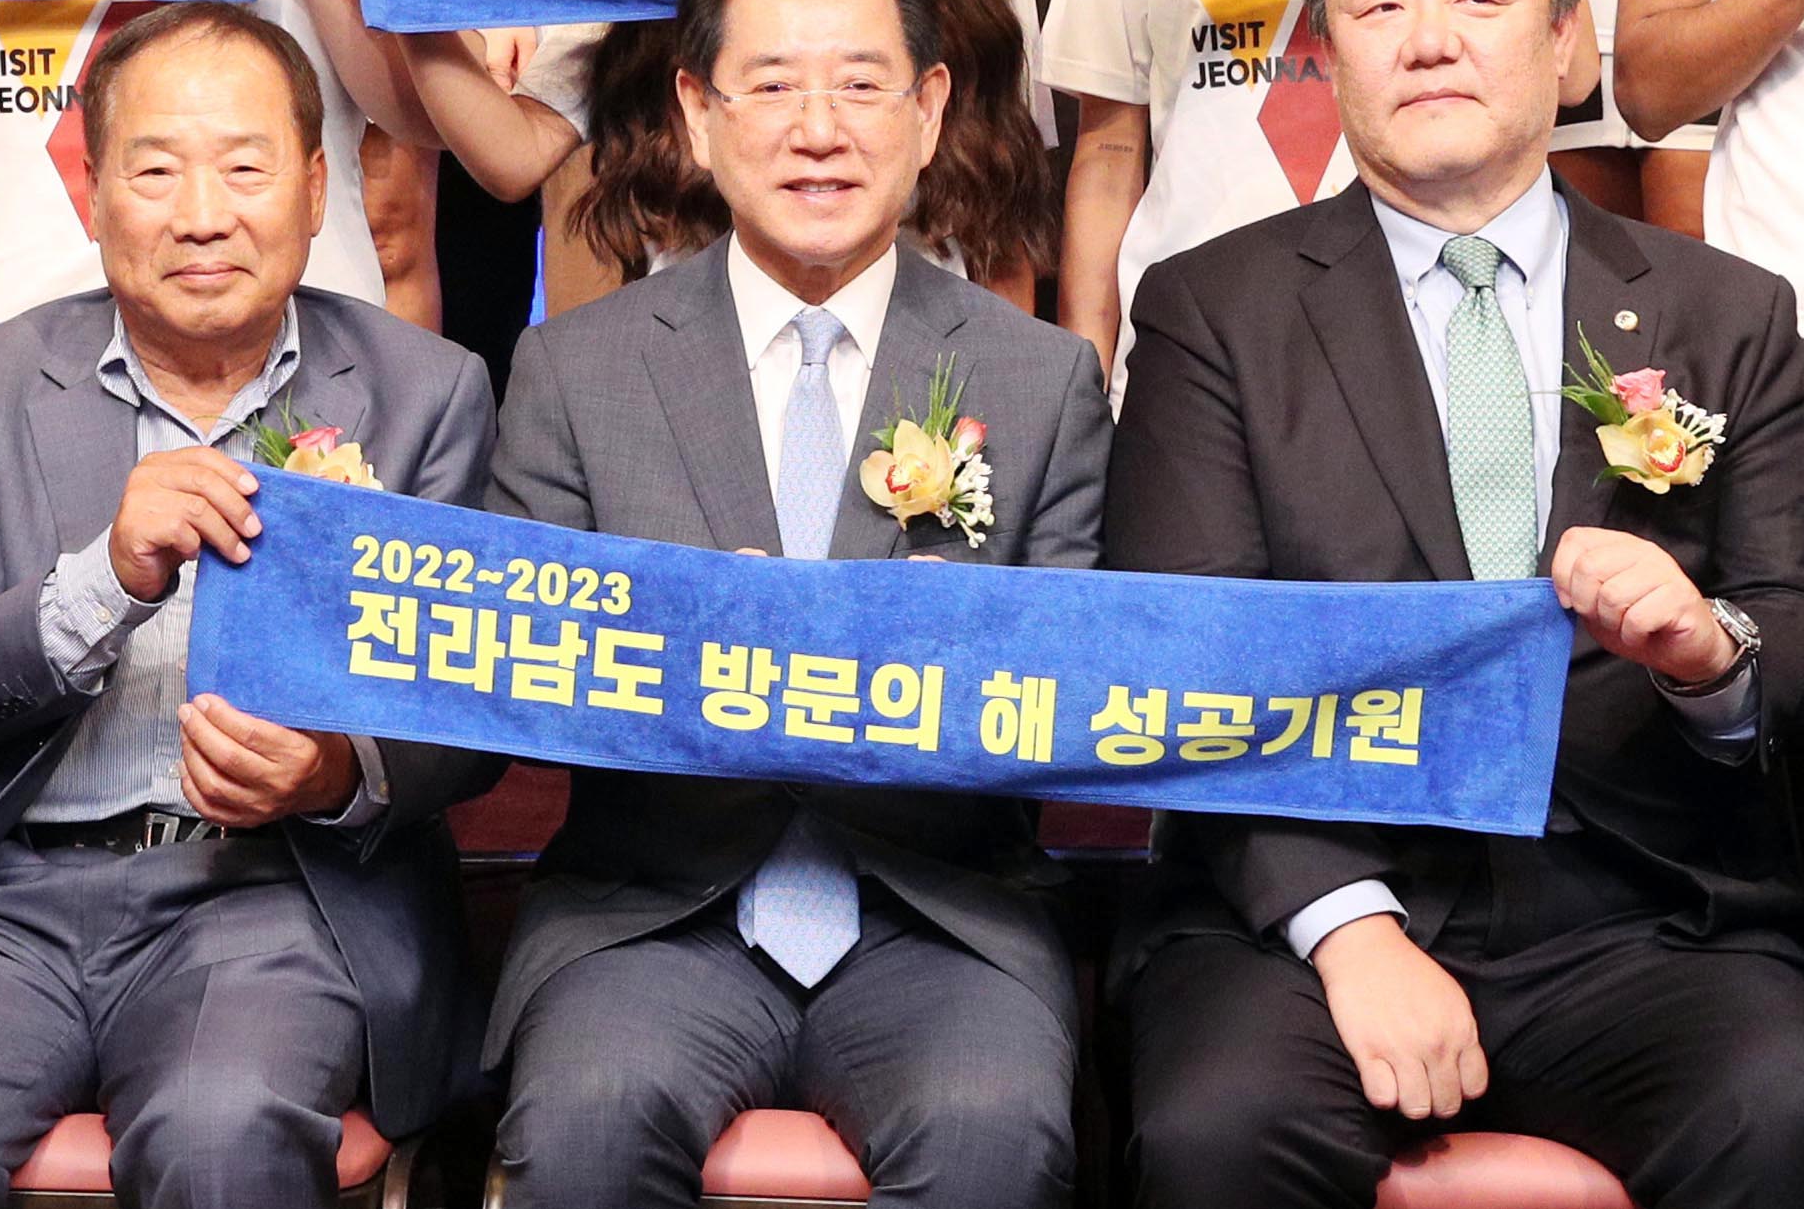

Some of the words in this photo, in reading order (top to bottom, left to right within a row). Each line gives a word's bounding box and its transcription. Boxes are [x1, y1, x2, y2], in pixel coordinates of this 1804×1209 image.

[1191, 21, 1265, 53] VISIT
[350, 535, 630, 614] 2022~2023
[346, 591, 664, 715] 전라남도
[700, 642, 939, 751] 방문의
[980, 670, 1056, 762] 해
[1095, 685, 1422, 766] 성공기원
